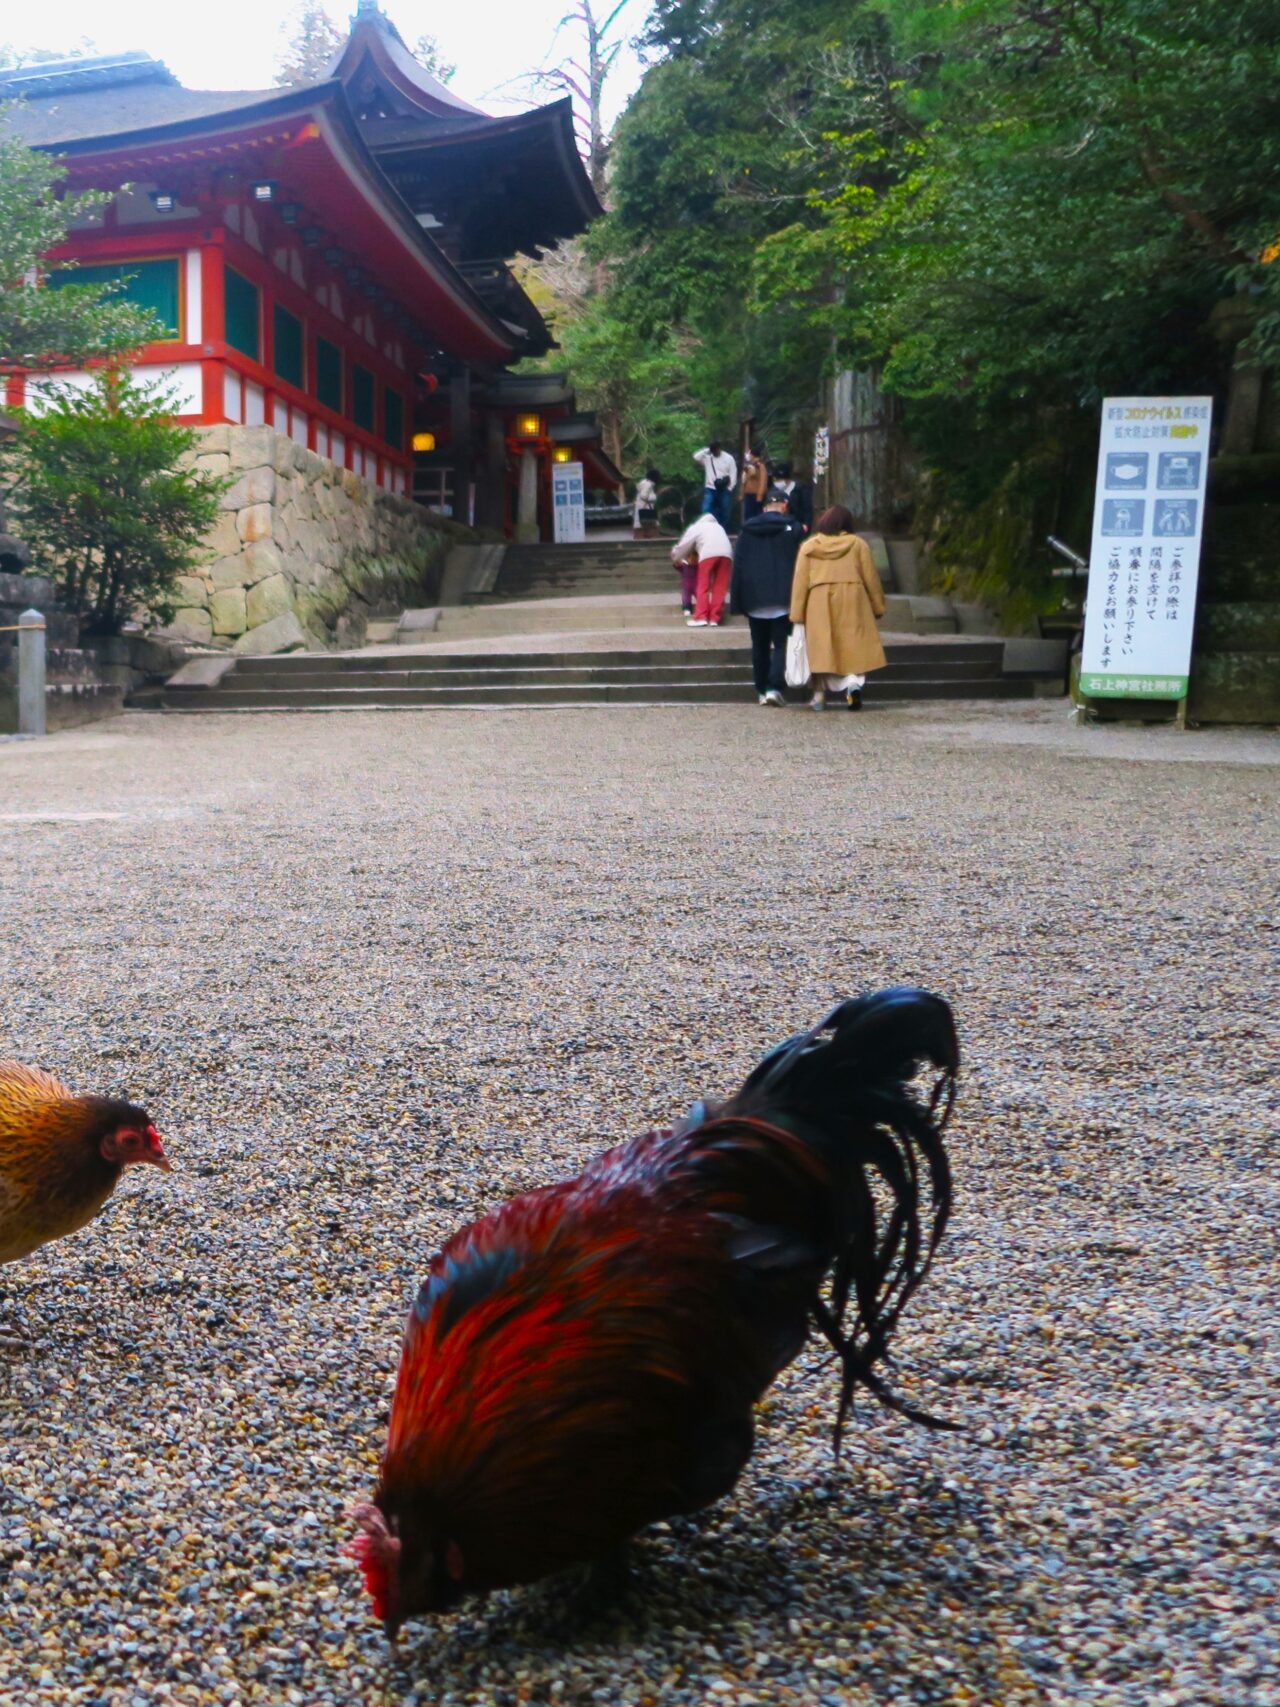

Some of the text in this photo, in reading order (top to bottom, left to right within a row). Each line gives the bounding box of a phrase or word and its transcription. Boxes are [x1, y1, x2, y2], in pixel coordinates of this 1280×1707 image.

[1100, 546, 1122, 669] ご協力をお願いします
[1122, 546, 1143, 656] 順番にお参り下さい
[1146, 546, 1163, 621] 間隔を空けて
[1165, 546, 1184, 620] ご参拝の際は
[1089, 679, 1182, 692] 石上神宮社務所
